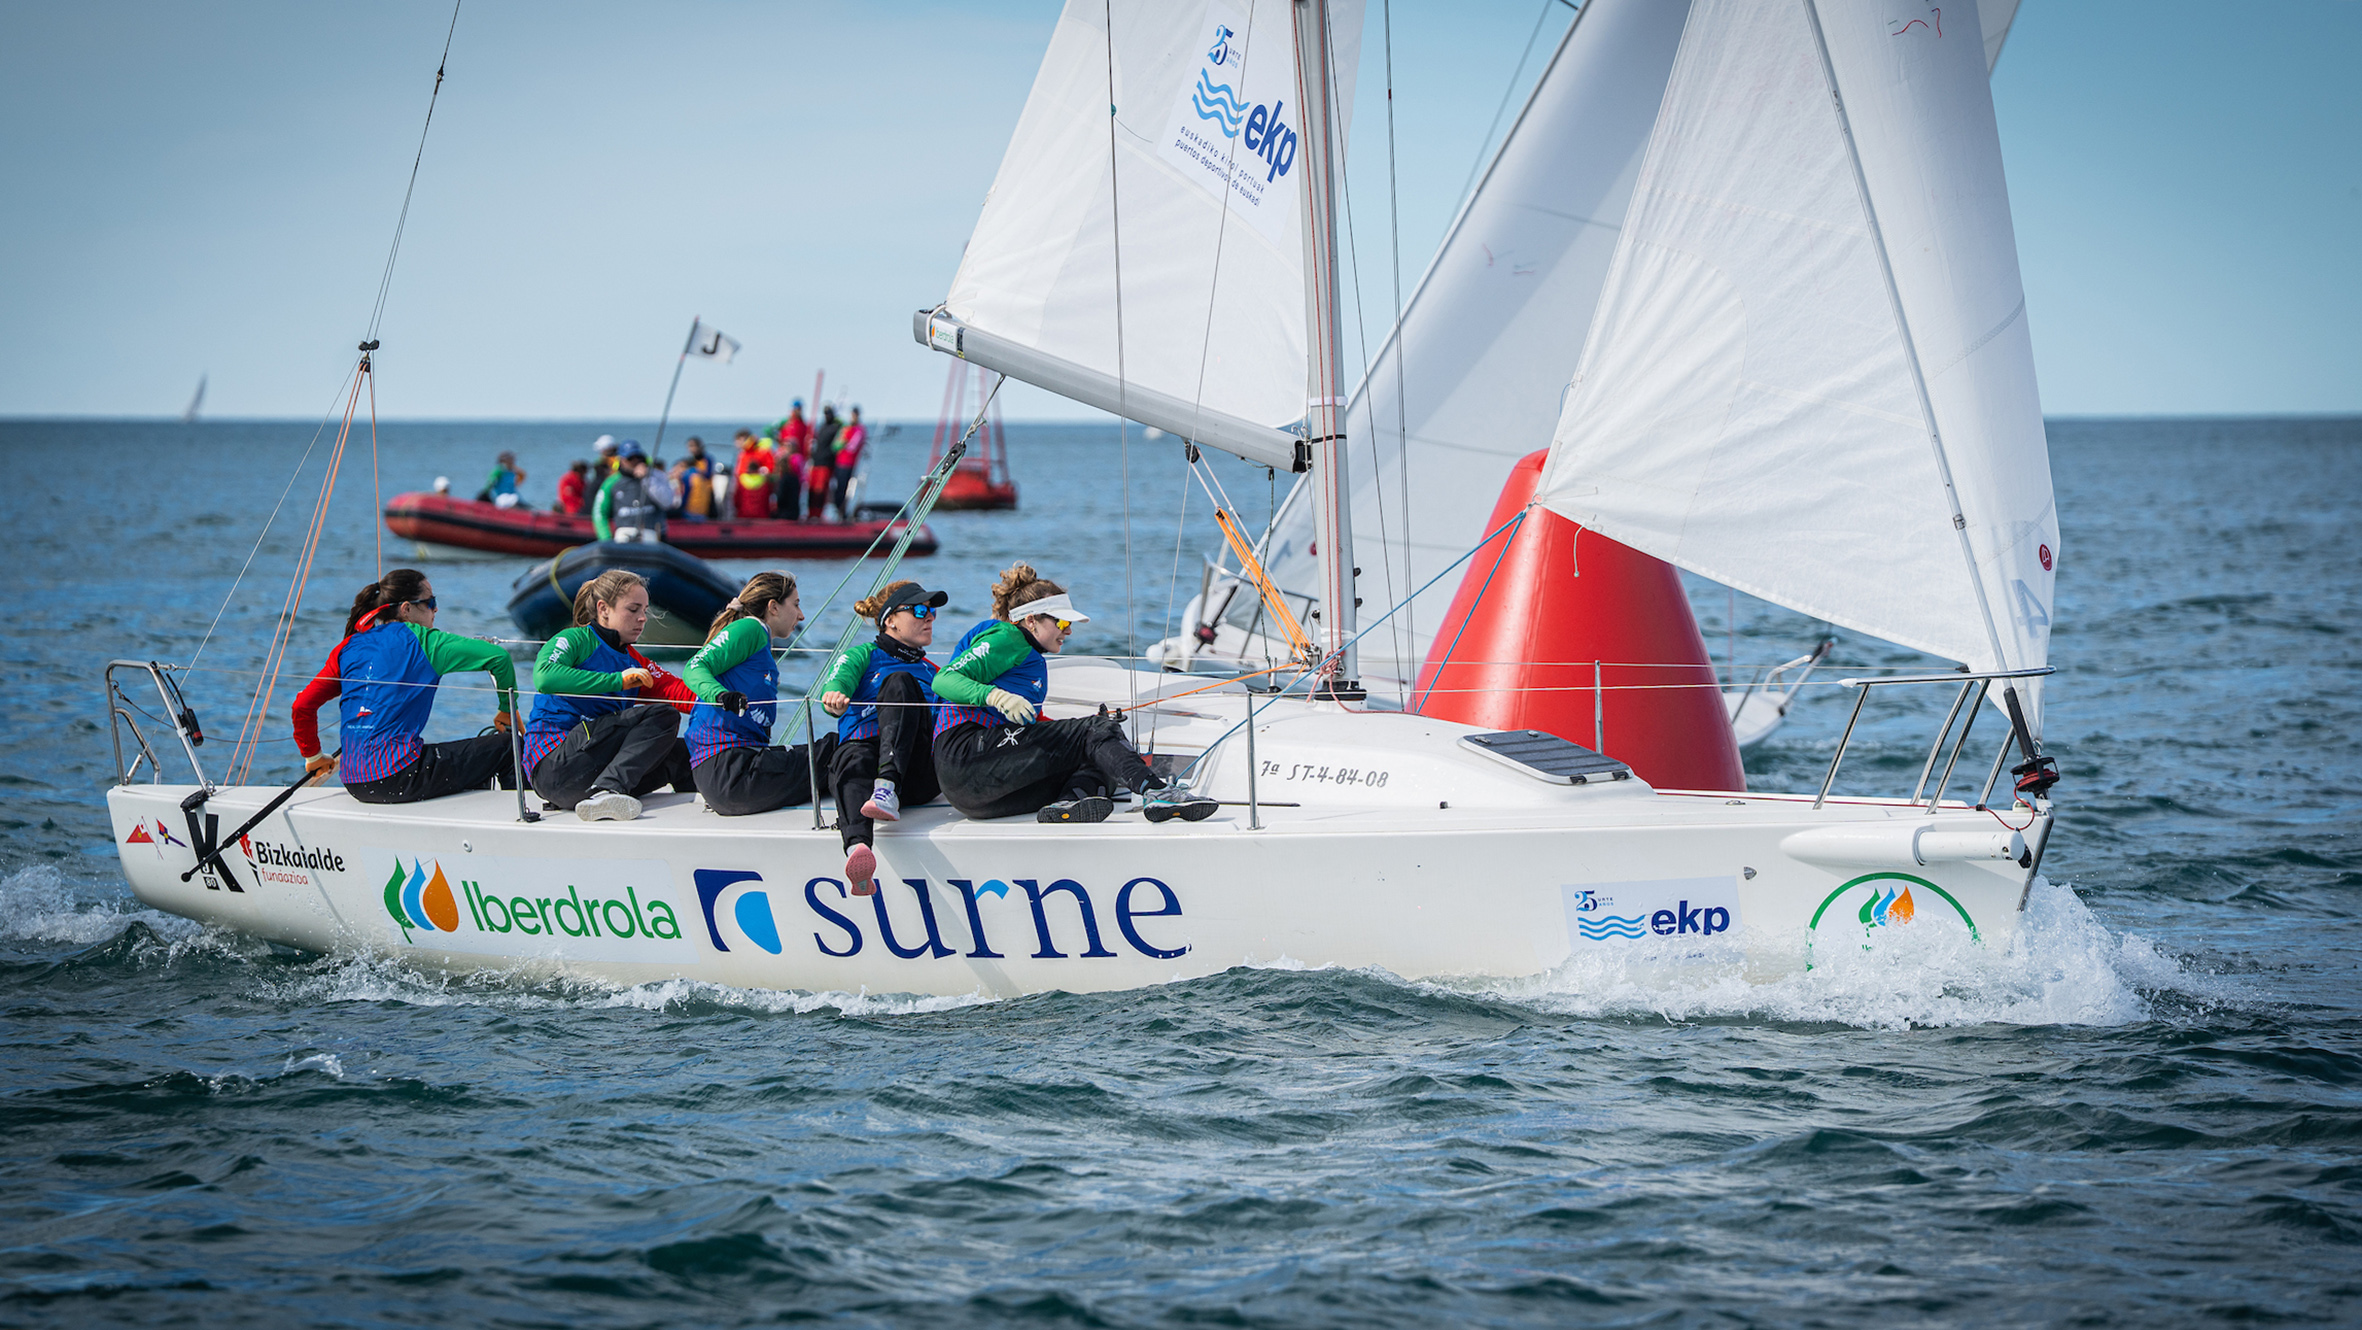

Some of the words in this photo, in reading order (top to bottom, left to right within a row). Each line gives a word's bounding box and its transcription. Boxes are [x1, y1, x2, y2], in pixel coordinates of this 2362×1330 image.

[1207, 24, 1234, 65] 25
[1180, 125, 1219, 158] euskadiko
[1238, 169, 1265, 194] portuak
[1244, 100, 1297, 183] ekp
[1174, 139, 1201, 160] puertos
[1231, 178, 1240, 190] de
[1239, 186, 1262, 208] euskadi
[701, 333, 720, 355] J
[255, 841, 345, 873] Bizkaialde
[261, 867, 309, 886] fundazioa
[461, 880, 682, 940] Iberdrola
[804, 876, 1192, 960] surne
[1574, 890, 1598, 912] 25
[1651, 900, 1730, 936] ekp
